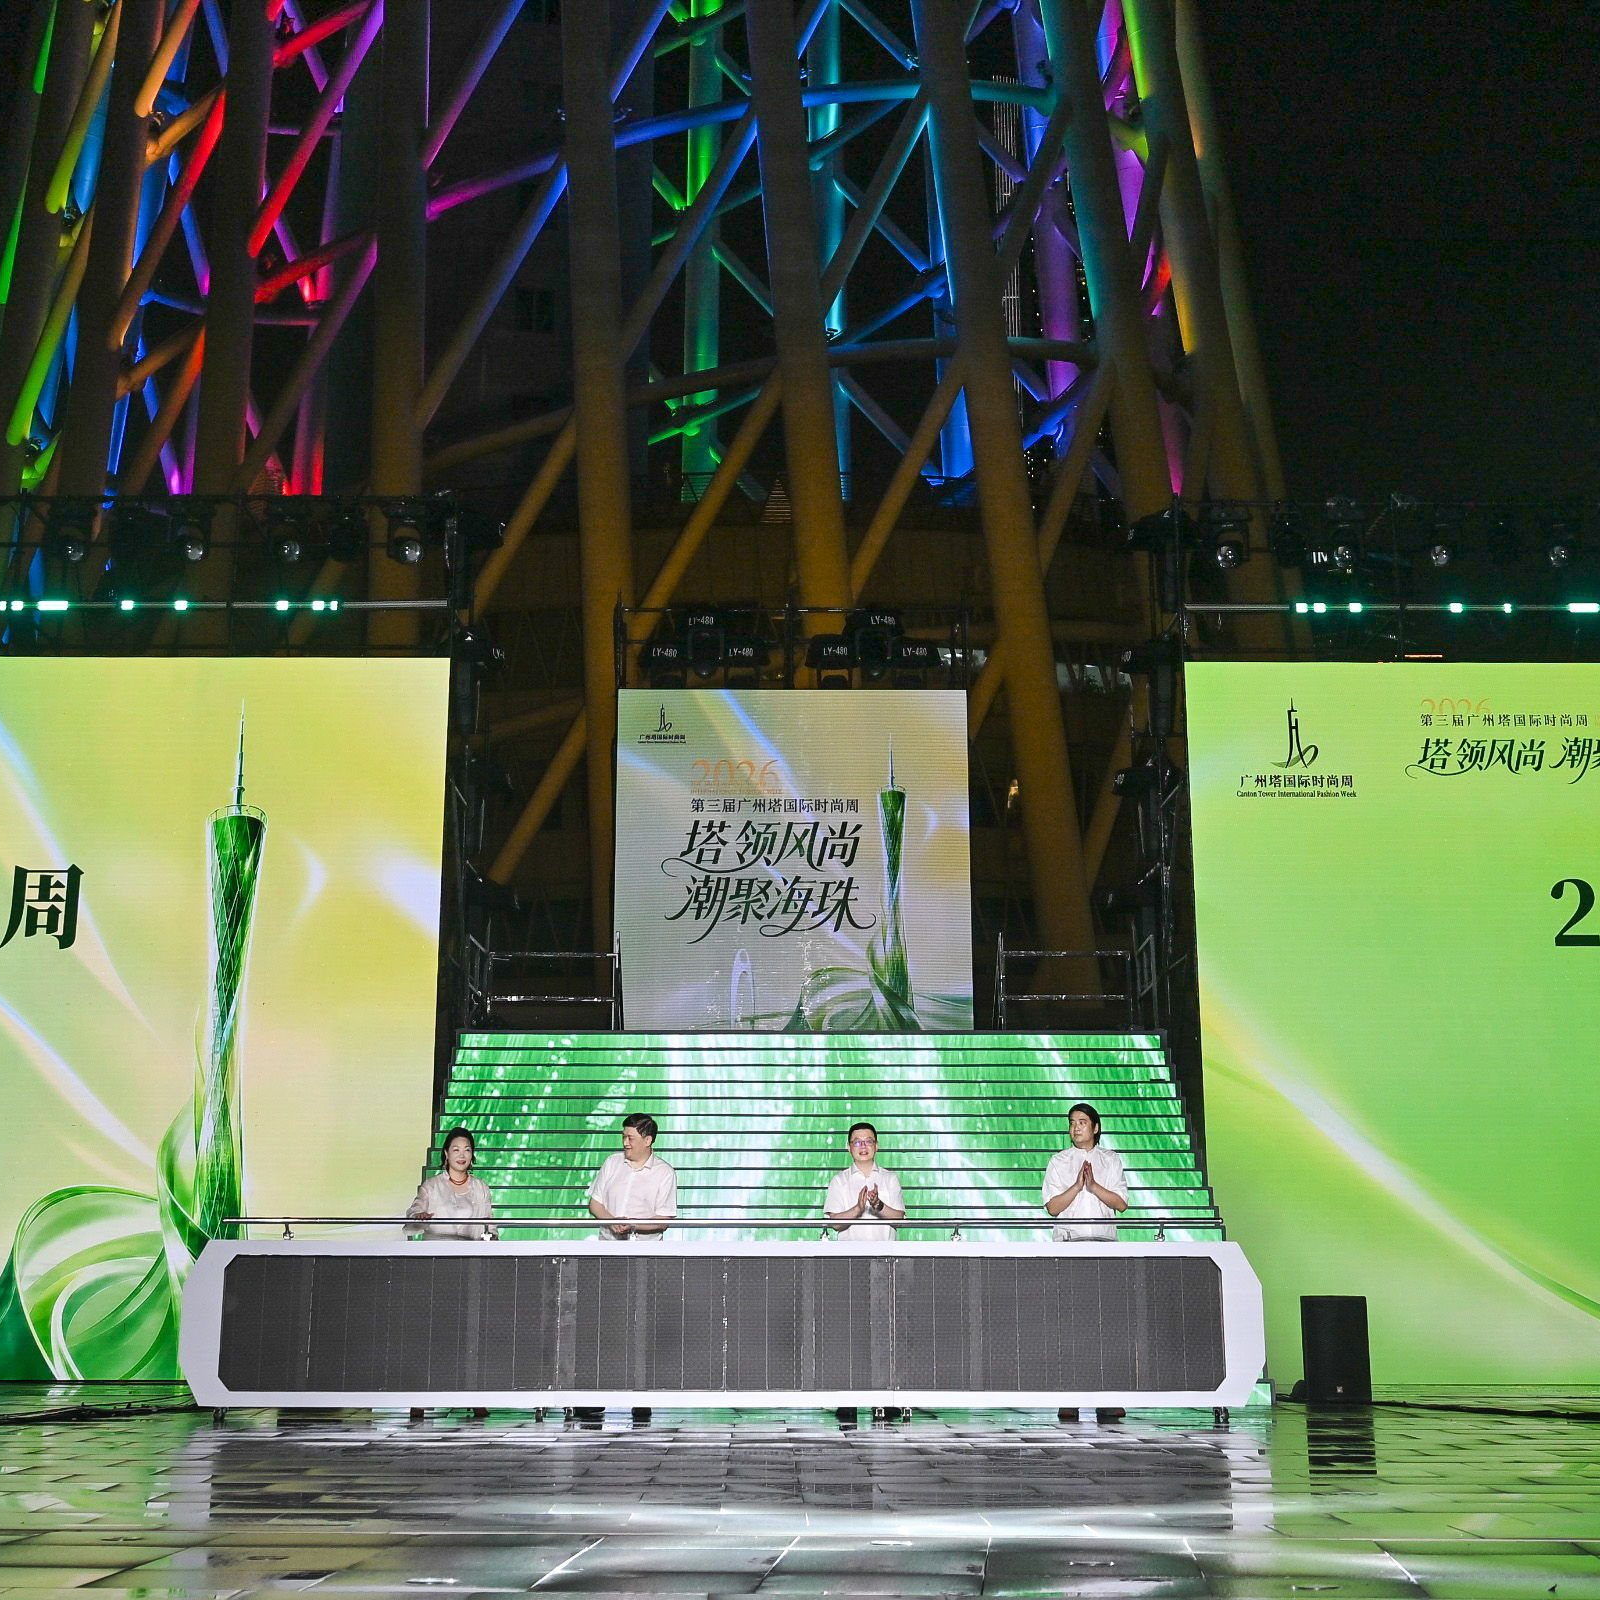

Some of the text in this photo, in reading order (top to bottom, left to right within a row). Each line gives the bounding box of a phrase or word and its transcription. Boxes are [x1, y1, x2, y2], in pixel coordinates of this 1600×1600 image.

[652, 647, 678, 657] LY-480
[729, 647, 754, 657] LY-480
[823, 646, 848, 656] LY-480
[902, 647, 928, 656] LY-480
[1420, 713, 1588, 727] 第三届广州塔国际时尚周
[1405, 737, 1546, 779] 塔领风尚
[1240, 774, 1353, 788] 广州塔国际时尚周
[1236, 790, 1357, 798] Canton Tower International Fashion Week
[690, 797, 859, 814] 第三届广州塔国际时尚周
[660, 819, 863, 878] 塔领风尚
[664, 875, 877, 945] 潮聚海珠
